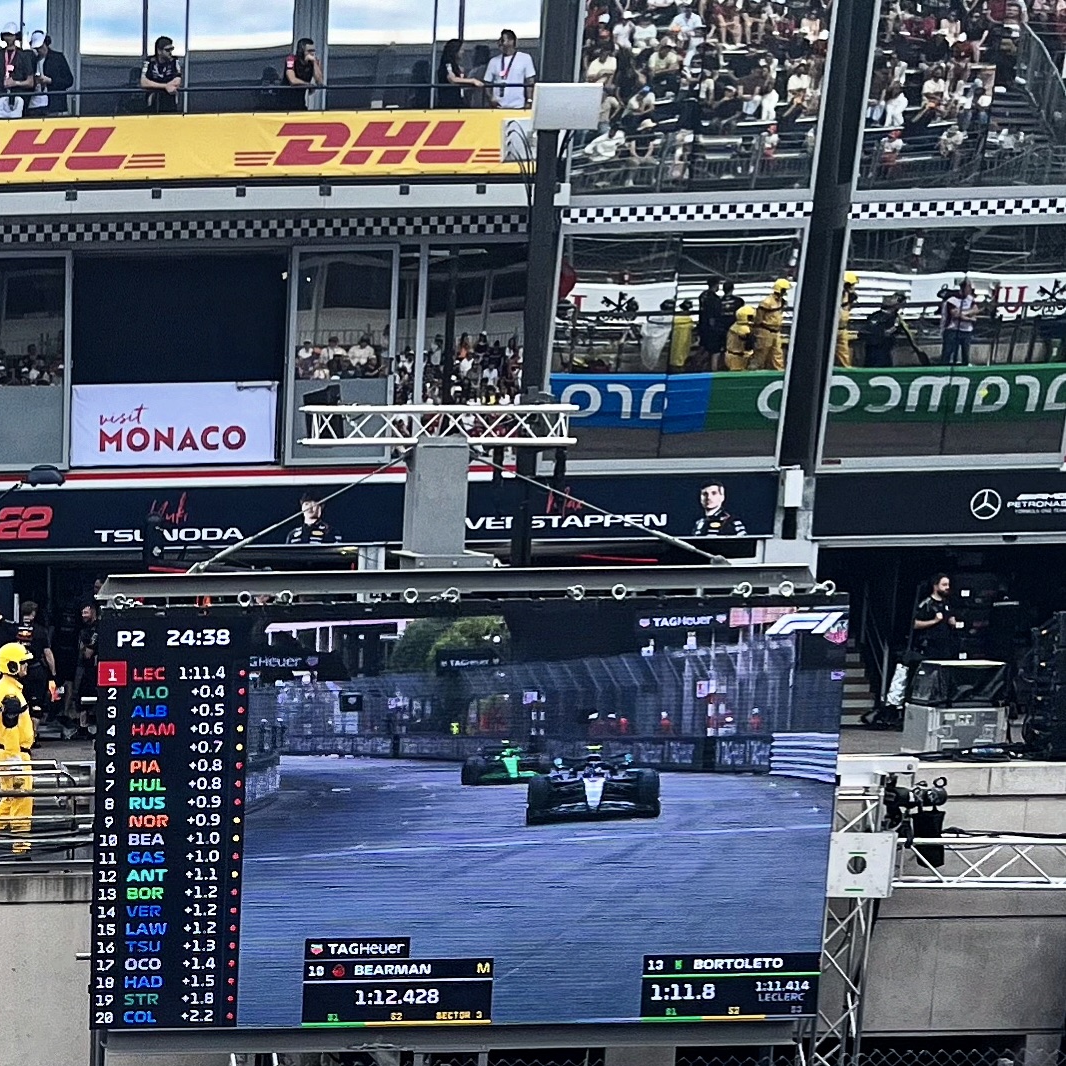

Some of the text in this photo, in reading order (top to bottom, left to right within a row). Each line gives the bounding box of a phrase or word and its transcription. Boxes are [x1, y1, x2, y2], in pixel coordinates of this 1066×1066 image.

[272, 120, 475, 167] DHL
[99, 403, 148, 426] visit
[99, 425, 247, 453] MONACO
[117, 629, 231, 648] P2 24:38
[108, 666, 226, 682] 1 LEC 1:11.4
[107, 685, 225, 700] 2 ALO +0.4
[107, 703, 225, 719] 3 ALB +0.5
[106, 722, 224, 736] 4 HAM +0.6
[106, 740, 223, 755] 5 SAI +0.7
[105, 758, 223, 773] 6 PIA +0.8
[105, 776, 222, 792] 7 HUL +0.8
[104, 795, 222, 810] 8 RUS +0.9
[104, 813, 221, 828] 9 NOR +0.9
[99, 832, 220, 847] 10 BEA +1.0
[99, 850, 220, 865] 11 GAS +1.0
[98, 867, 218, 883] 12 ANT +1.1
[98, 885, 218, 901] 13 BOR +1.2
[97, 903, 218, 919] 14 VER +1.2
[97, 921, 217, 936] 15 LAW +1.2
[96, 939, 216, 954] 16 TSU +1.3
[96, 957, 216, 972] 17 OCO +1.4
[354, 963, 432, 976] BEARMAN
[476, 962, 491, 974] M
[647, 957, 784, 971] 13 BORTOLETO
[95, 974, 215, 989] 18 HAD +1.5
[95, 991, 214, 1006] 19 STR +1.8
[355, 988, 440, 1006] 1:12.428
[650, 983, 716, 1000] 1:11.8
[758, 992, 805, 1002] LECLERC
[95, 1009, 214, 1024] 20 COL +2.2
[436, 1011, 471, 1020] SECTOR
